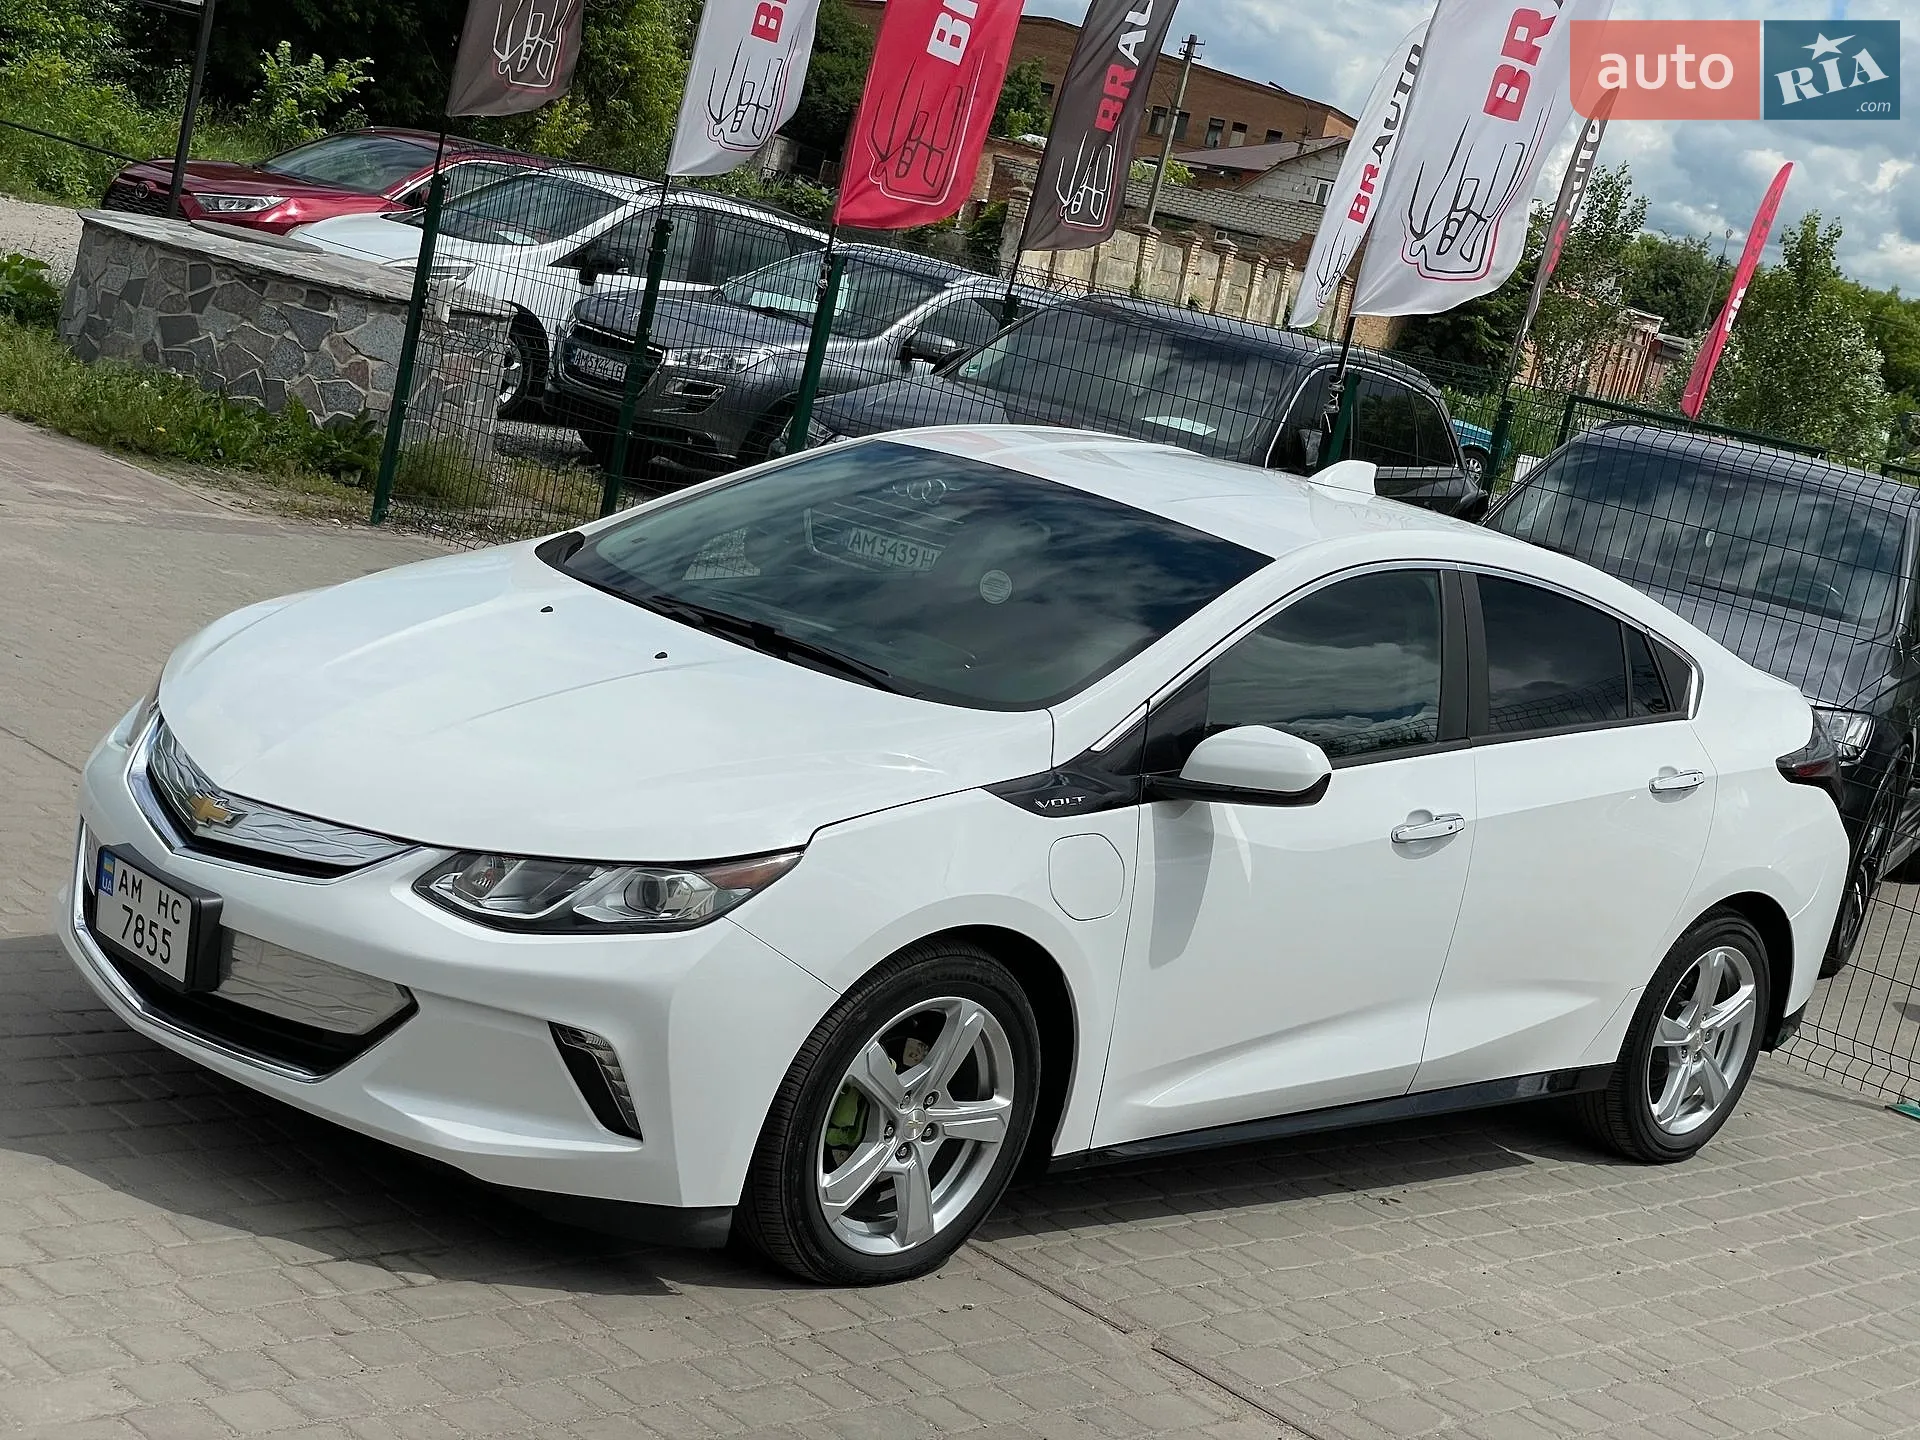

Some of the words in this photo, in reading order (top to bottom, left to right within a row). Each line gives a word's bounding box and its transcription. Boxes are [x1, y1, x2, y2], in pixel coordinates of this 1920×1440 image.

[1034, 796, 1086, 809] VOLT
[102, 877, 112, 893] UA
[118, 869, 143, 903] AM
[157, 889, 181, 924] HC
[121, 903, 172, 964] 7855
